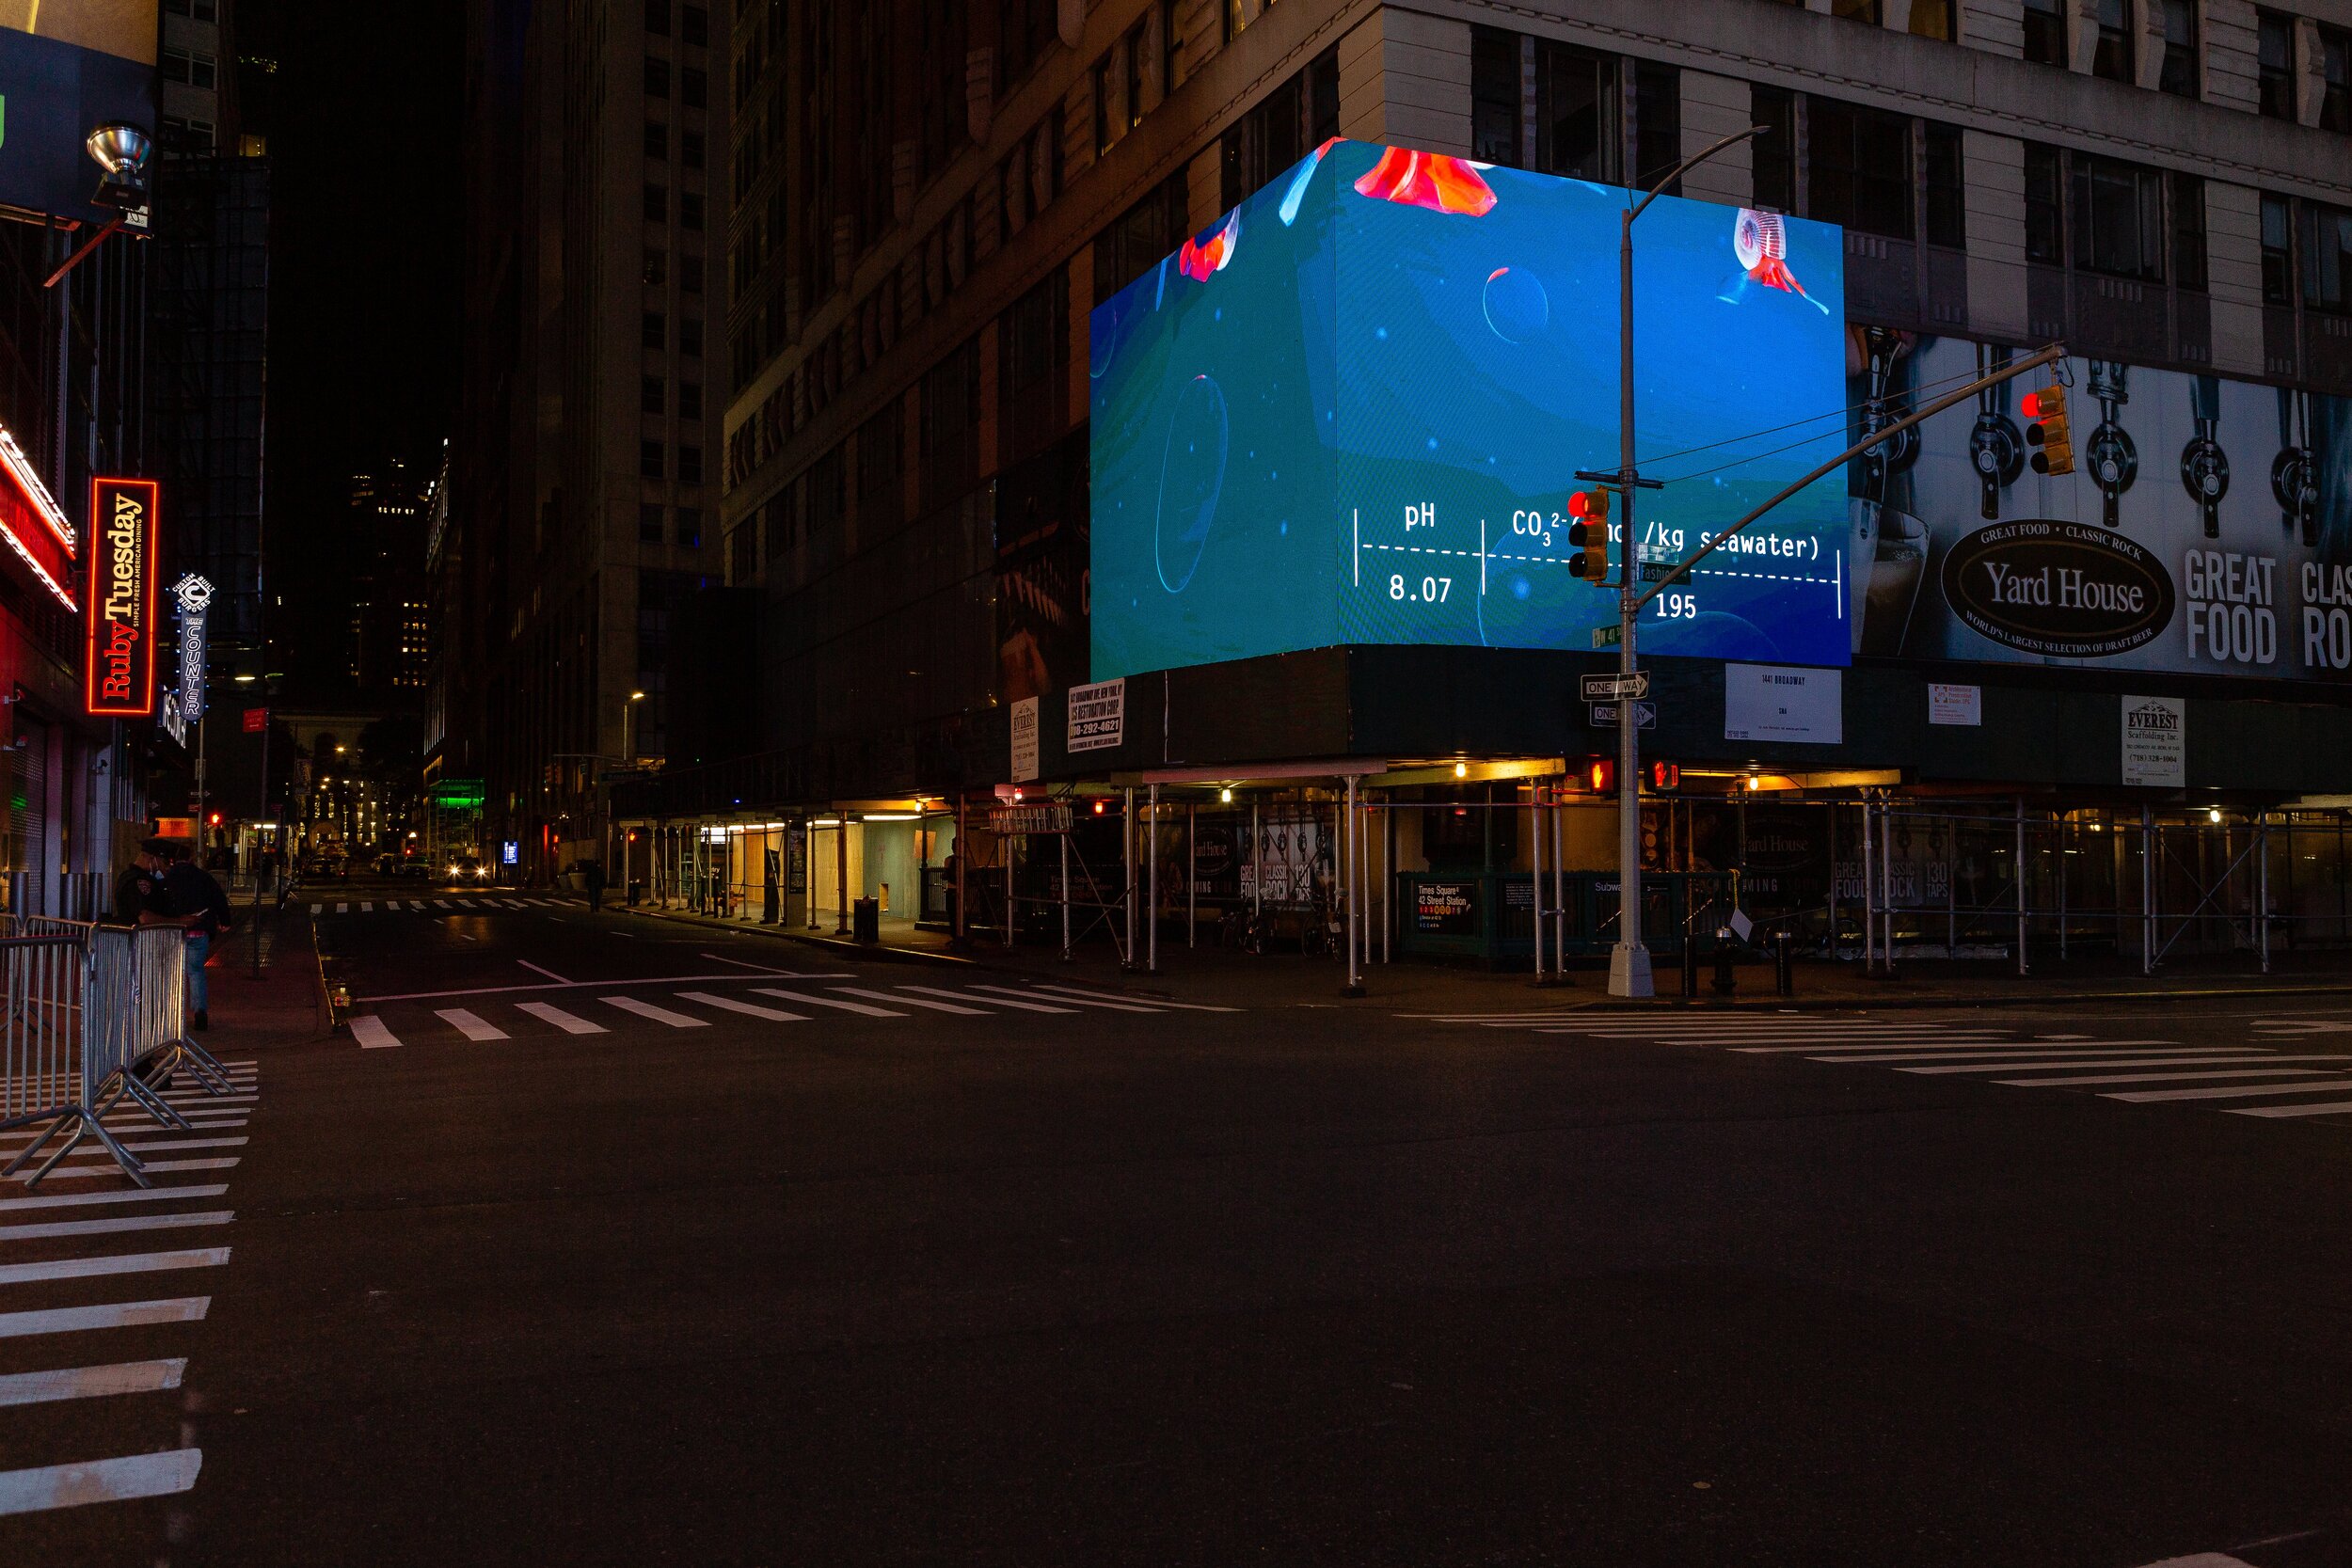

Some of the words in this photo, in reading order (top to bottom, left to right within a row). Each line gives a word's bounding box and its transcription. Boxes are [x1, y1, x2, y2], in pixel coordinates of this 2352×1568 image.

[1405, 501, 1435, 531] pH
[1980, 525, 2016, 545] GREAT
[2019, 523, 2049, 535] FOOD
[2066, 525, 2110, 546] CLASSIC
[2111, 537, 2142, 562] ROCK
[105, 493, 143, 621] Tuesday
[172, 572, 196, 593] CUSTOM
[197, 575, 216, 593] BUILT
[2185, 548, 2276, 606] GREAT
[1390, 574, 1452, 603] 8.07
[1983, 561, 2052, 607] Yard
[2057, 568, 2145, 613] House
[177, 596, 211, 612] BURGERS
[1656, 593, 1696, 619] 195
[184, 617, 204, 626] THE
[1608, 627, 1615, 642] 41
[1965, 610, 2003, 638] WORLD'S
[2004, 633, 2044, 650] LARGEST
[2044, 642, 2091, 654] SELECTION
[2092, 641, 2104, 653] OF
[2105, 638, 2132, 652] DRAFT
[2132, 627, 2153, 643] BEER
[2185, 600, 2277, 664] FOOD
[2302, 606, 2351, 669] RO
[103, 619, 139, 700] Ruby
[184, 626, 201, 715] COUNTER
[1589, 683, 1613, 693] ONE
[1623, 680, 1644, 691] WAY
[1762, 674, 1773, 684] 1441
[1774, 674, 1805, 686] BROADWAY
[1077, 702, 1106, 721] RESTORATION
[1597, 708, 1616, 719] ONE
[2128, 712, 2179, 729] EVEREST
[2127, 730, 2165, 742] Scaffolding
[2167, 733, 2179, 741] Inc.
[1206, 841, 1228, 857] House
[1771, 834, 1808, 852] House
[1240, 864, 1255, 881] GREA
[1878, 861, 1915, 877] CASSIC
[1926, 861, 1947, 883] 130
[1185, 880, 1212, 894] CMING
[1240, 881, 1255, 899] FOO
[1418, 885, 1435, 895] Times
[1436, 885, 1456, 895] Square
[1595, 881, 1621, 892] Subwa
[1727, 879, 1778, 893] CMING
[1926, 884, 1948, 897] TAPS
[1418, 895, 1426, 905] 42
[1427, 895, 1445, 905] Street
[1446, 895, 1467, 906] Station
